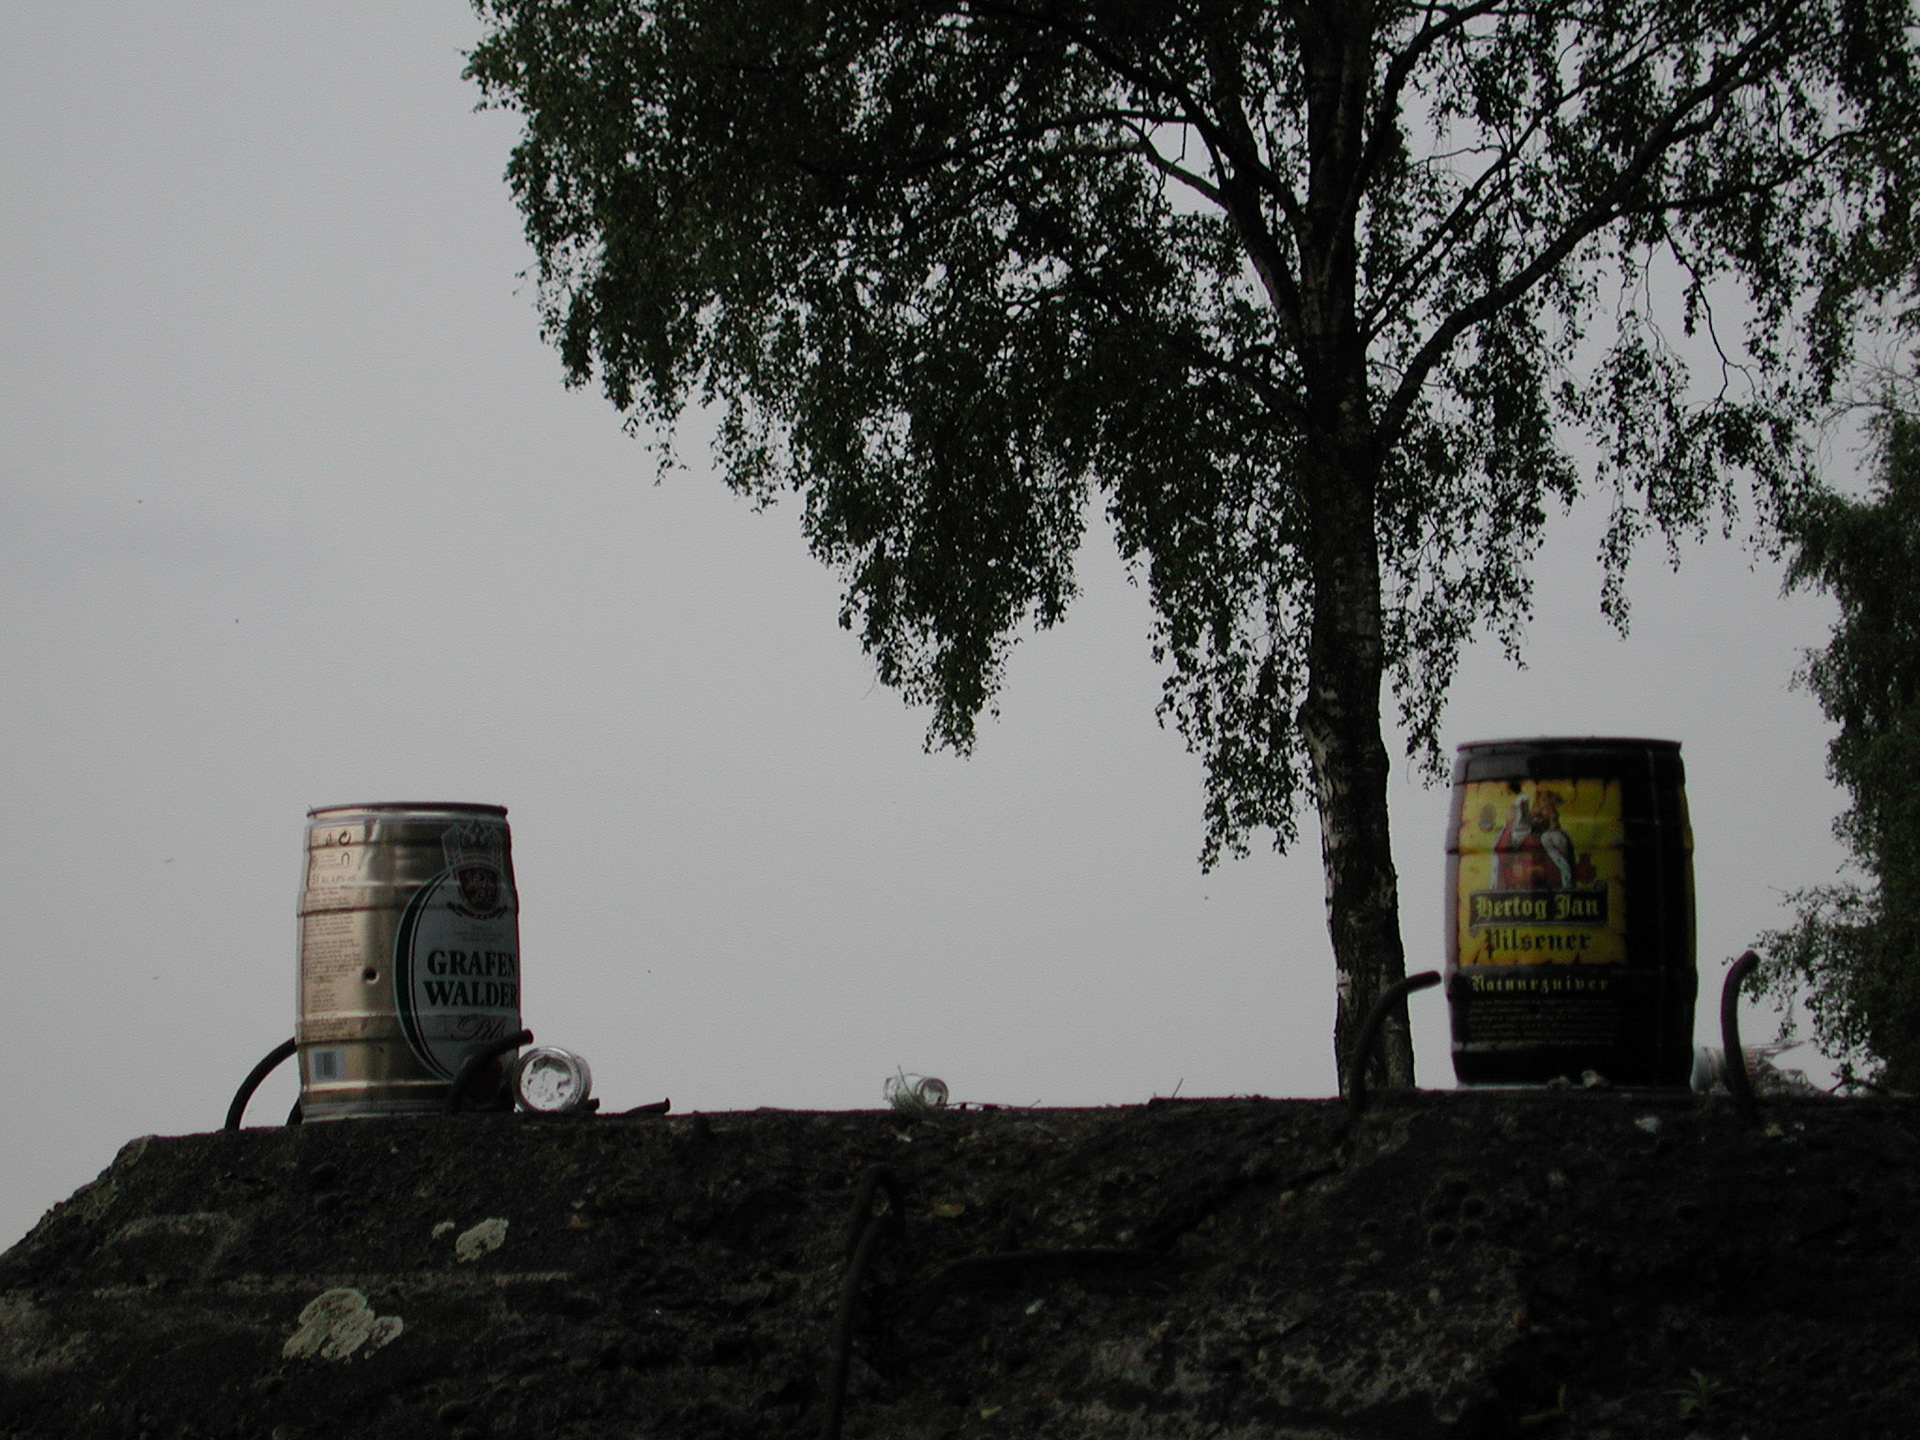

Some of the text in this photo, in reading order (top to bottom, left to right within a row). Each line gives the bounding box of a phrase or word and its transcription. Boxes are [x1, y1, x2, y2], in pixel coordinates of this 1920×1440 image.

[1475, 892, 1601, 920] Hertog Jan
[1484, 927, 1593, 960] Pilsener
[427, 950, 517, 978] GRAFEN
[422, 980, 518, 1008] WALDER
